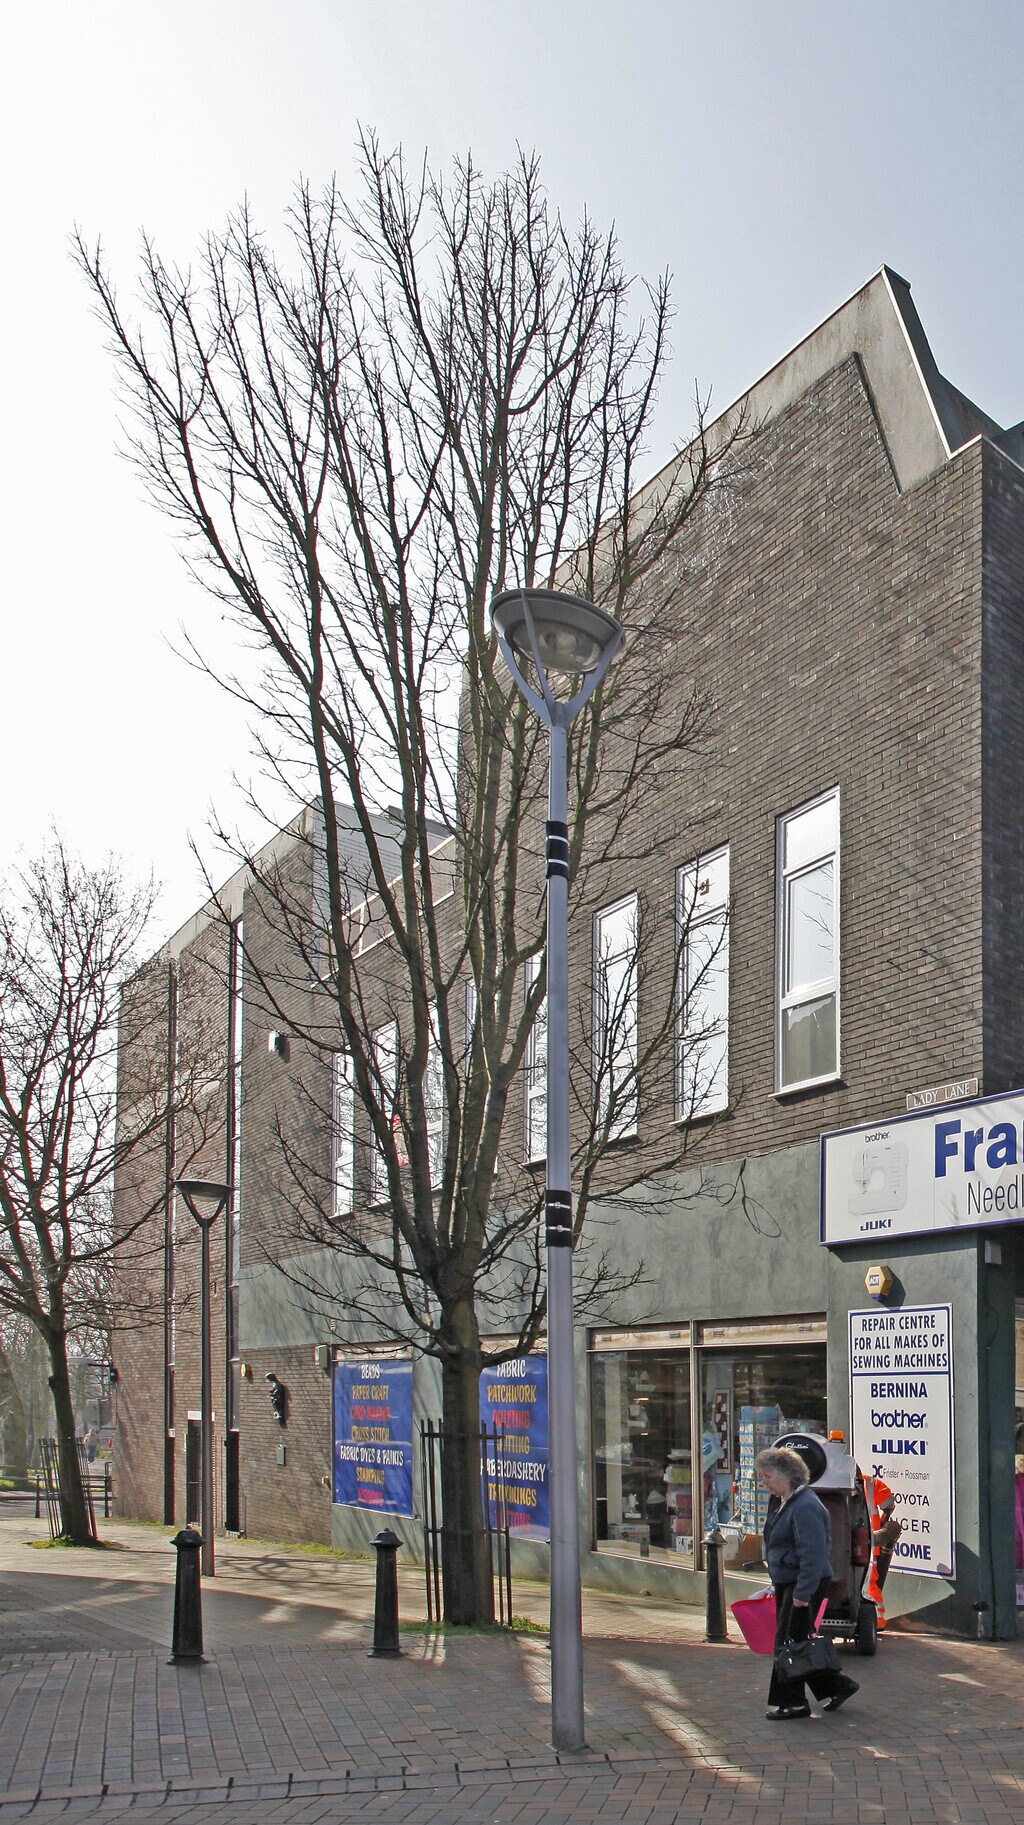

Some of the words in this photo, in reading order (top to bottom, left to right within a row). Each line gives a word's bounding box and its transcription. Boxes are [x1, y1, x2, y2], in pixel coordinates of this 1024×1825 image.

[914, 1090, 938, 1106] LADY
[945, 1083, 970, 1099] LANE
[865, 1131, 890, 1143] brother
[860, 1219, 892, 1231] JUKI
[862, 1317, 895, 1331] REPAIR
[899, 1315, 935, 1330] CENTRE
[854, 1337, 871, 1350] FOR
[875, 1336, 890, 1350] ALL
[894, 1334, 928, 1349] MAKES
[932, 1333, 945, 1347] OF
[853, 1355, 890, 1368] SEWING
[894, 1353, 947, 1368] MACHINES
[362, 1364, 380, 1379] BEADS
[371, 1385, 389, 1400] CRAFT
[487, 1385, 537, 1403] PATCHWORK
[871, 1382, 928, 1398] BERNINA
[871, 1409, 927, 1428] brother
[340, 1445, 359, 1461] FABRIC
[360, 1447, 375, 1463] DYES
[377, 1449, 381, 1463] &
[872, 1439, 925, 1455] JUKI
[892, 1493, 930, 1506] OYOTA
